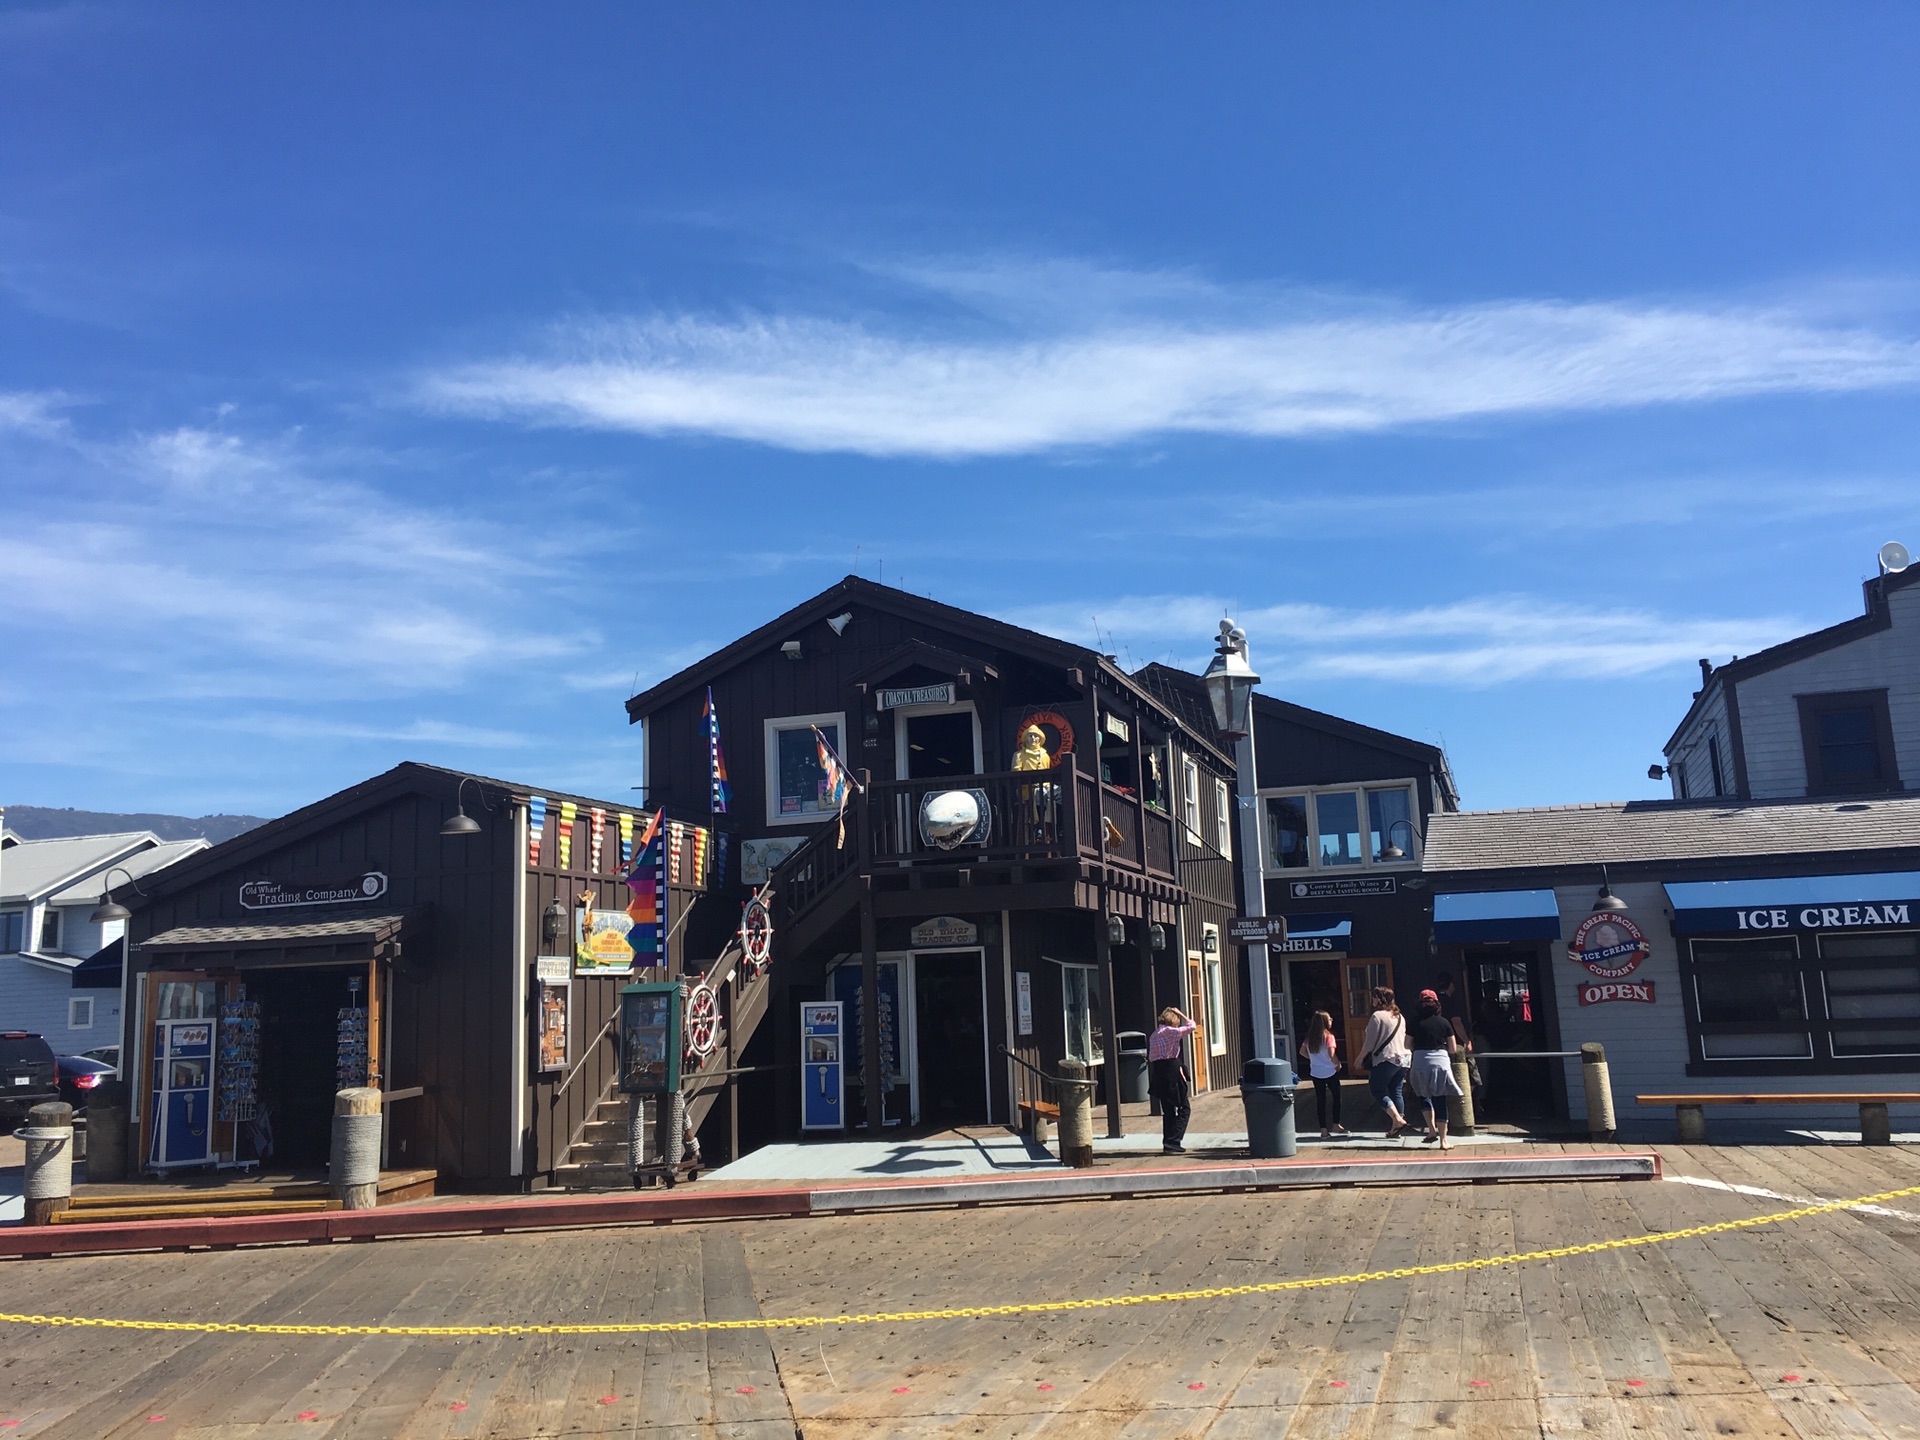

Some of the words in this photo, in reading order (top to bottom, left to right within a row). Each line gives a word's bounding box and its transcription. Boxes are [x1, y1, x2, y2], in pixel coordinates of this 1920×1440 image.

[885, 691, 912, 706] COASTAL
[912, 686, 948, 702] TREASURES
[245, 887, 257, 895] Old
[257, 884, 281, 894] Wharf
[257, 892, 301, 904] Trading
[305, 888, 358, 903] Company
[1737, 909, 1789, 929] ICE
[1800, 905, 1910, 928] CREAM
[1231, 928, 1267, 936] RESTROOMS
[1576, 930, 1586, 946] THE
[1583, 914, 1608, 930] GREAT
[1612, 915, 1641, 938] PACIFIC
[917, 936, 952, 944] TRADING
[1272, 938, 1332, 953] SHELLS
[1583, 951, 1600, 960] ICE
[1602, 943, 1635, 957] CREAM
[1589, 962, 1635, 977] COMPANY
[1585, 984, 1649, 1002] OPEN
